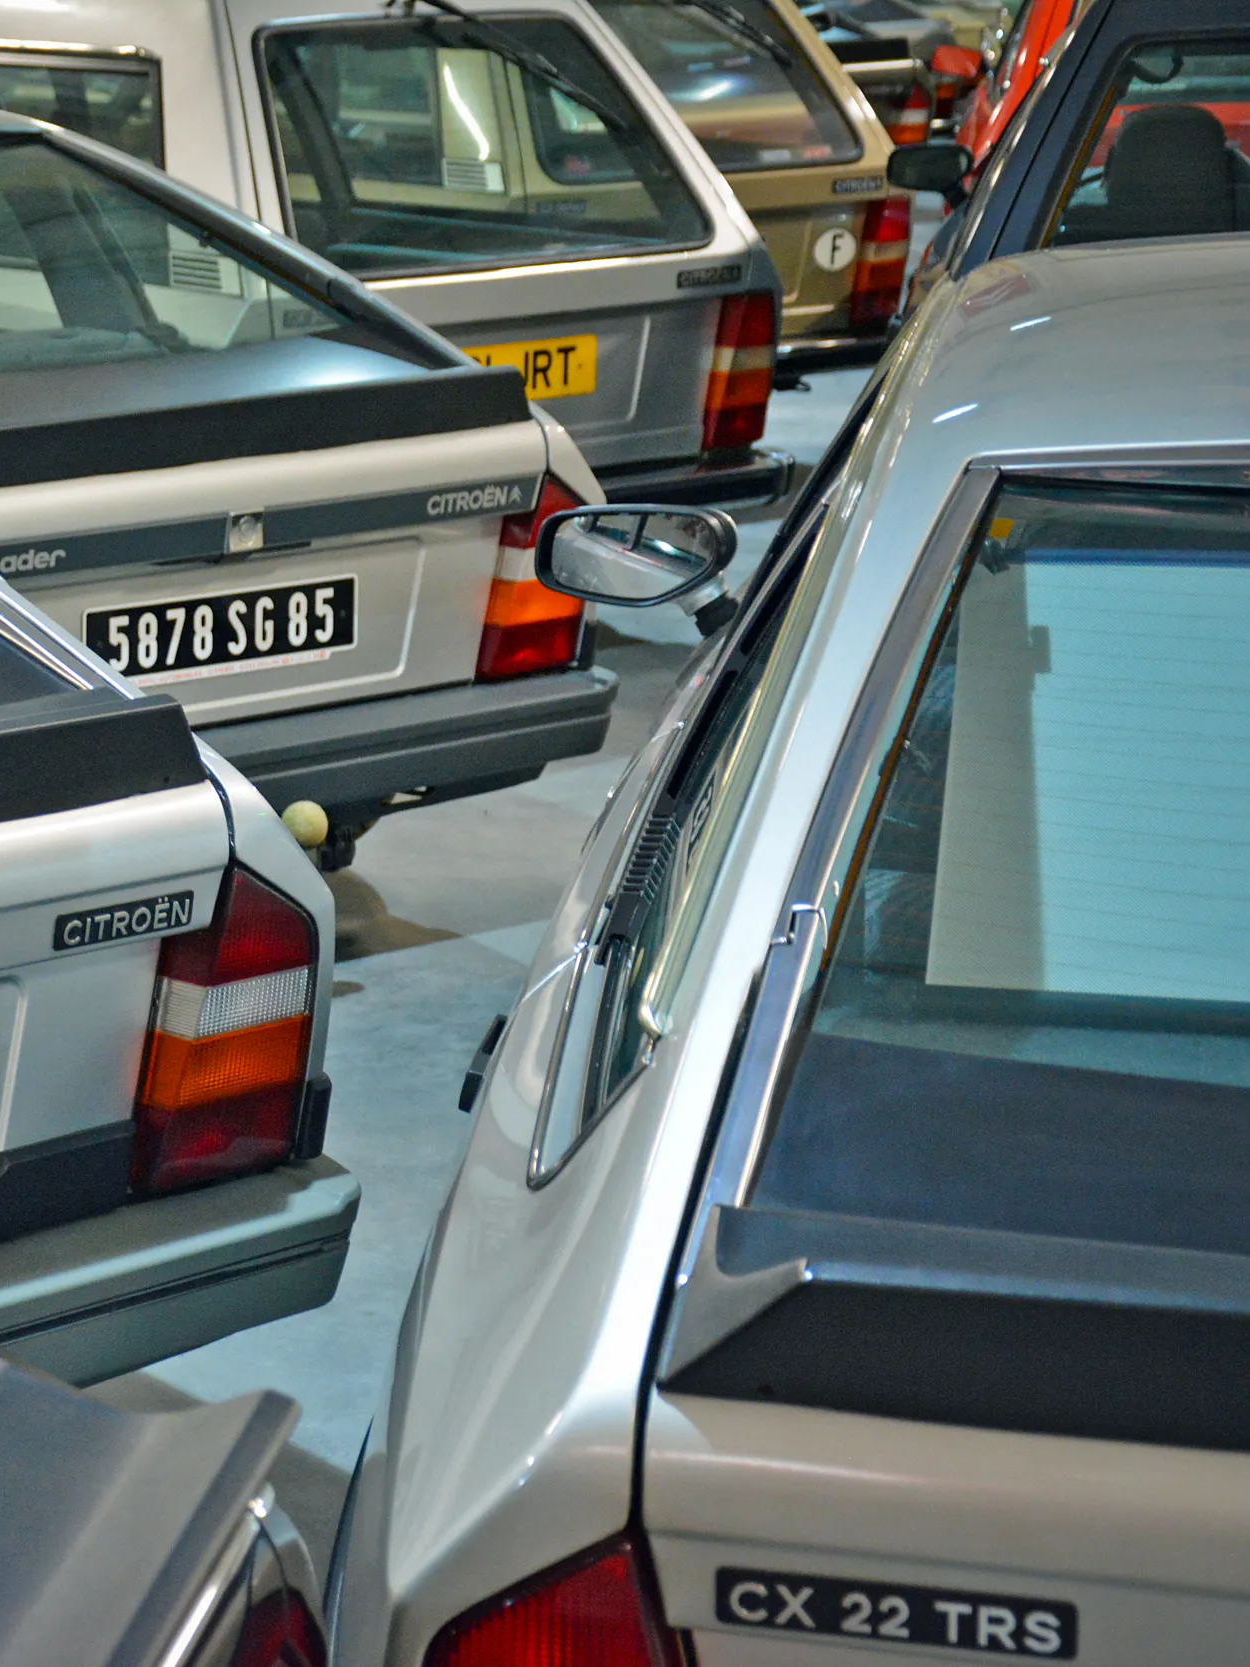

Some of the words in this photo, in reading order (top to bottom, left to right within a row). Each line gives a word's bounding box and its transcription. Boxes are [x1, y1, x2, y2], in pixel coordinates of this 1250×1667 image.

[831, 234, 845, 265] F
[427, 484, 509, 516] CITROËN
[108, 605, 214, 672] 5878
[227, 596, 275, 656] SG
[287, 587, 335, 647] 85
[63, 896, 191, 946] CITROËN
[729, 1582, 817, 1628] CX
[840, 1592, 910, 1639] 22
[934, 1600, 1062, 1654] TRS
